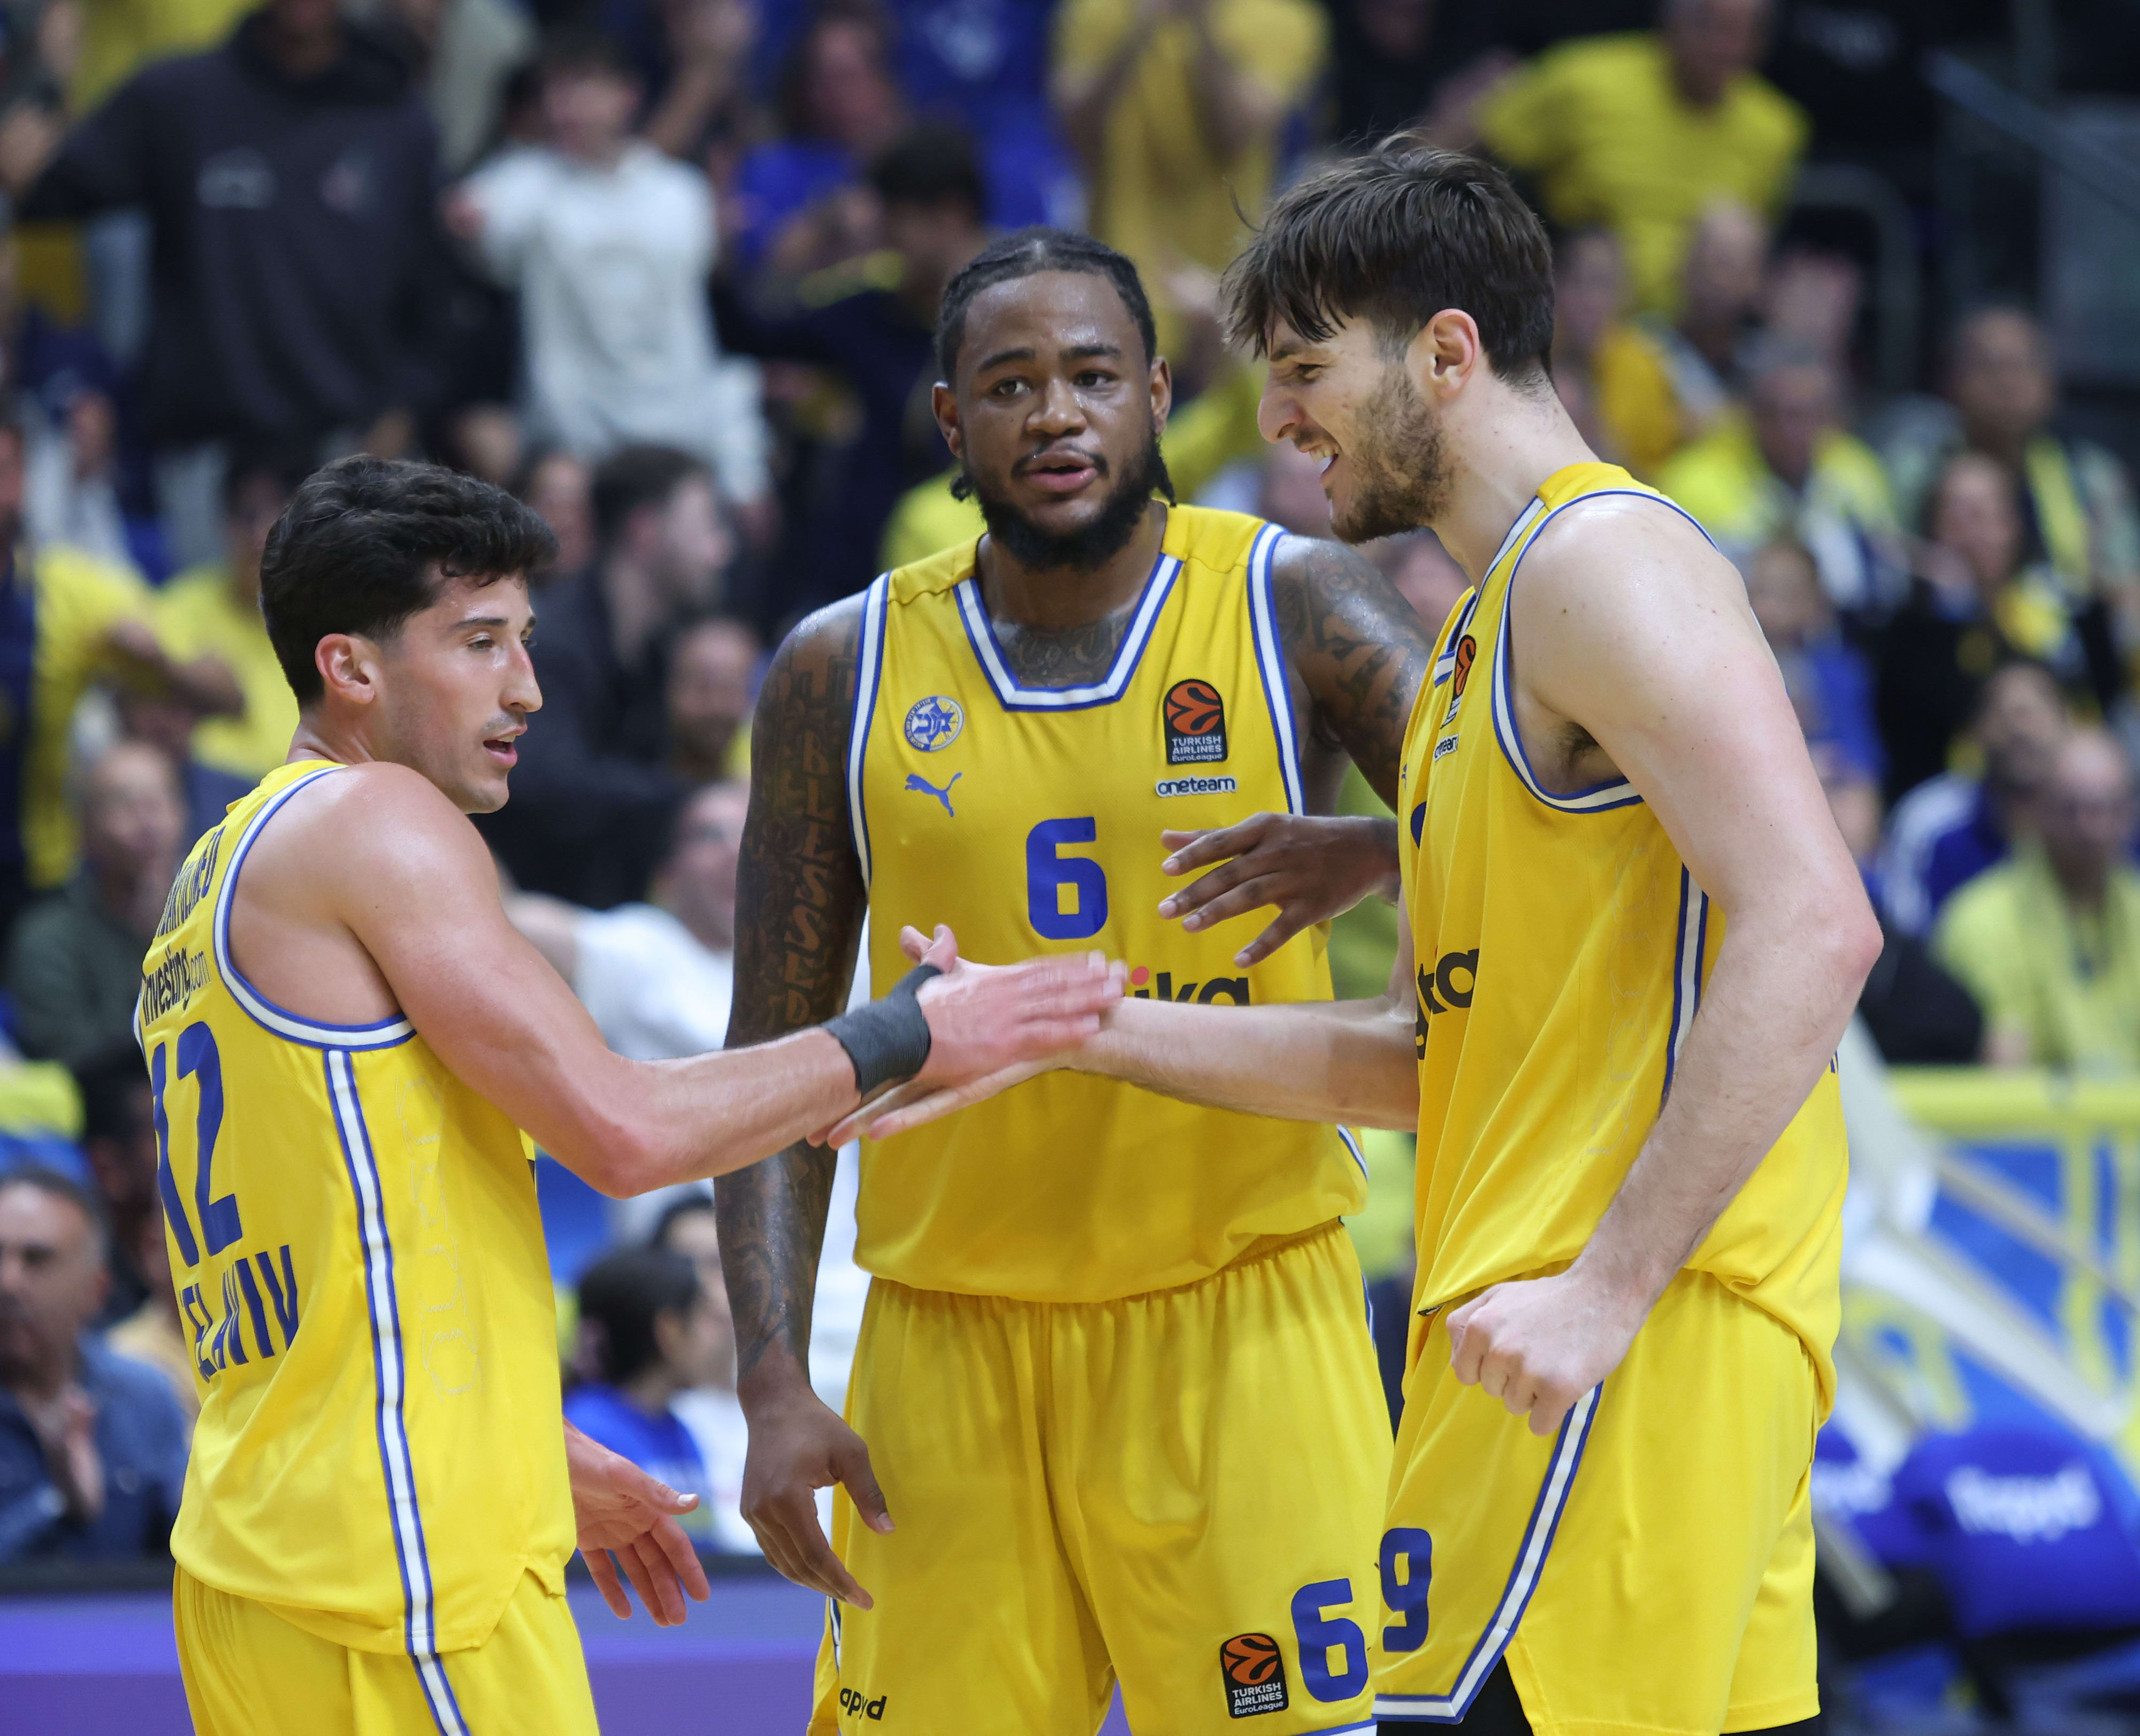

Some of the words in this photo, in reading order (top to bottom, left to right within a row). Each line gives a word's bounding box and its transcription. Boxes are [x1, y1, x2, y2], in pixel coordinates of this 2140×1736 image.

[1172, 736, 1221, 746] TURKISH
[1172, 744, 1221, 755] AIRLINES
[1172, 753, 1222, 762] EuroLeague
[1157, 777, 1236, 794] oneteam
[1026, 816, 1109, 940] 6
[151, 1021, 243, 1268] 12
[179, 1282, 218, 1383] EL
[1380, 1527, 1432, 1653] 9
[1290, 1578, 1369, 1703] 6
[1232, 1682, 1281, 1698] TURKISH
[1234, 1692, 1283, 1707] AIRLINES
[1234, 1701, 1284, 1715] EuroLeague
